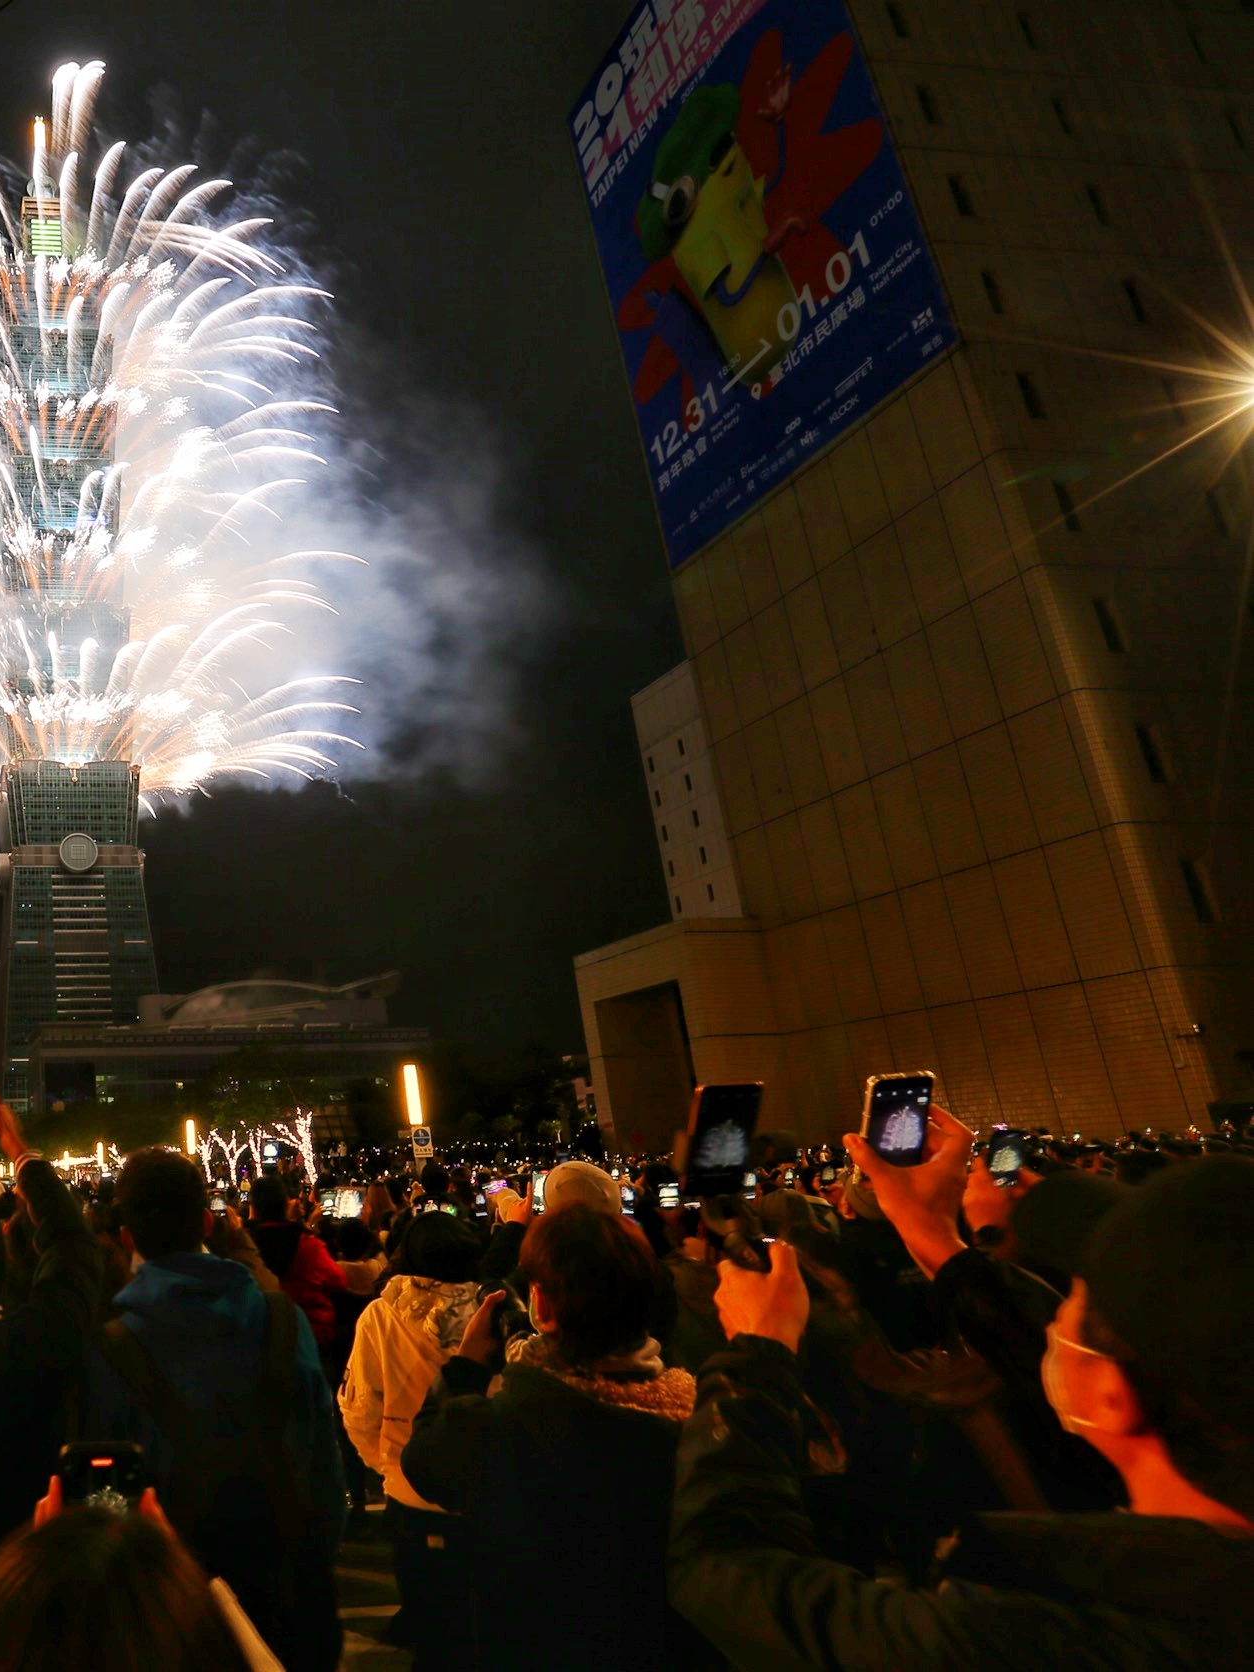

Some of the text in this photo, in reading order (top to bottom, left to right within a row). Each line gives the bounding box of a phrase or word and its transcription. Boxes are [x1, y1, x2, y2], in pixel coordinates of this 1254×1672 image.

[590, 0, 743, 208] TAIPEI NEW YEAR'S EV
[869, 190, 903, 227] 01:00
[776, 229, 871, 342] 01.01
[868, 240, 914, 282] Taipei City
[872, 247, 922, 294] Hall Square
[768, 285, 866, 388] 臺北市民廣場
[650, 381, 718, 466] 12.31
[828, 394, 860, 424] KLOOK
